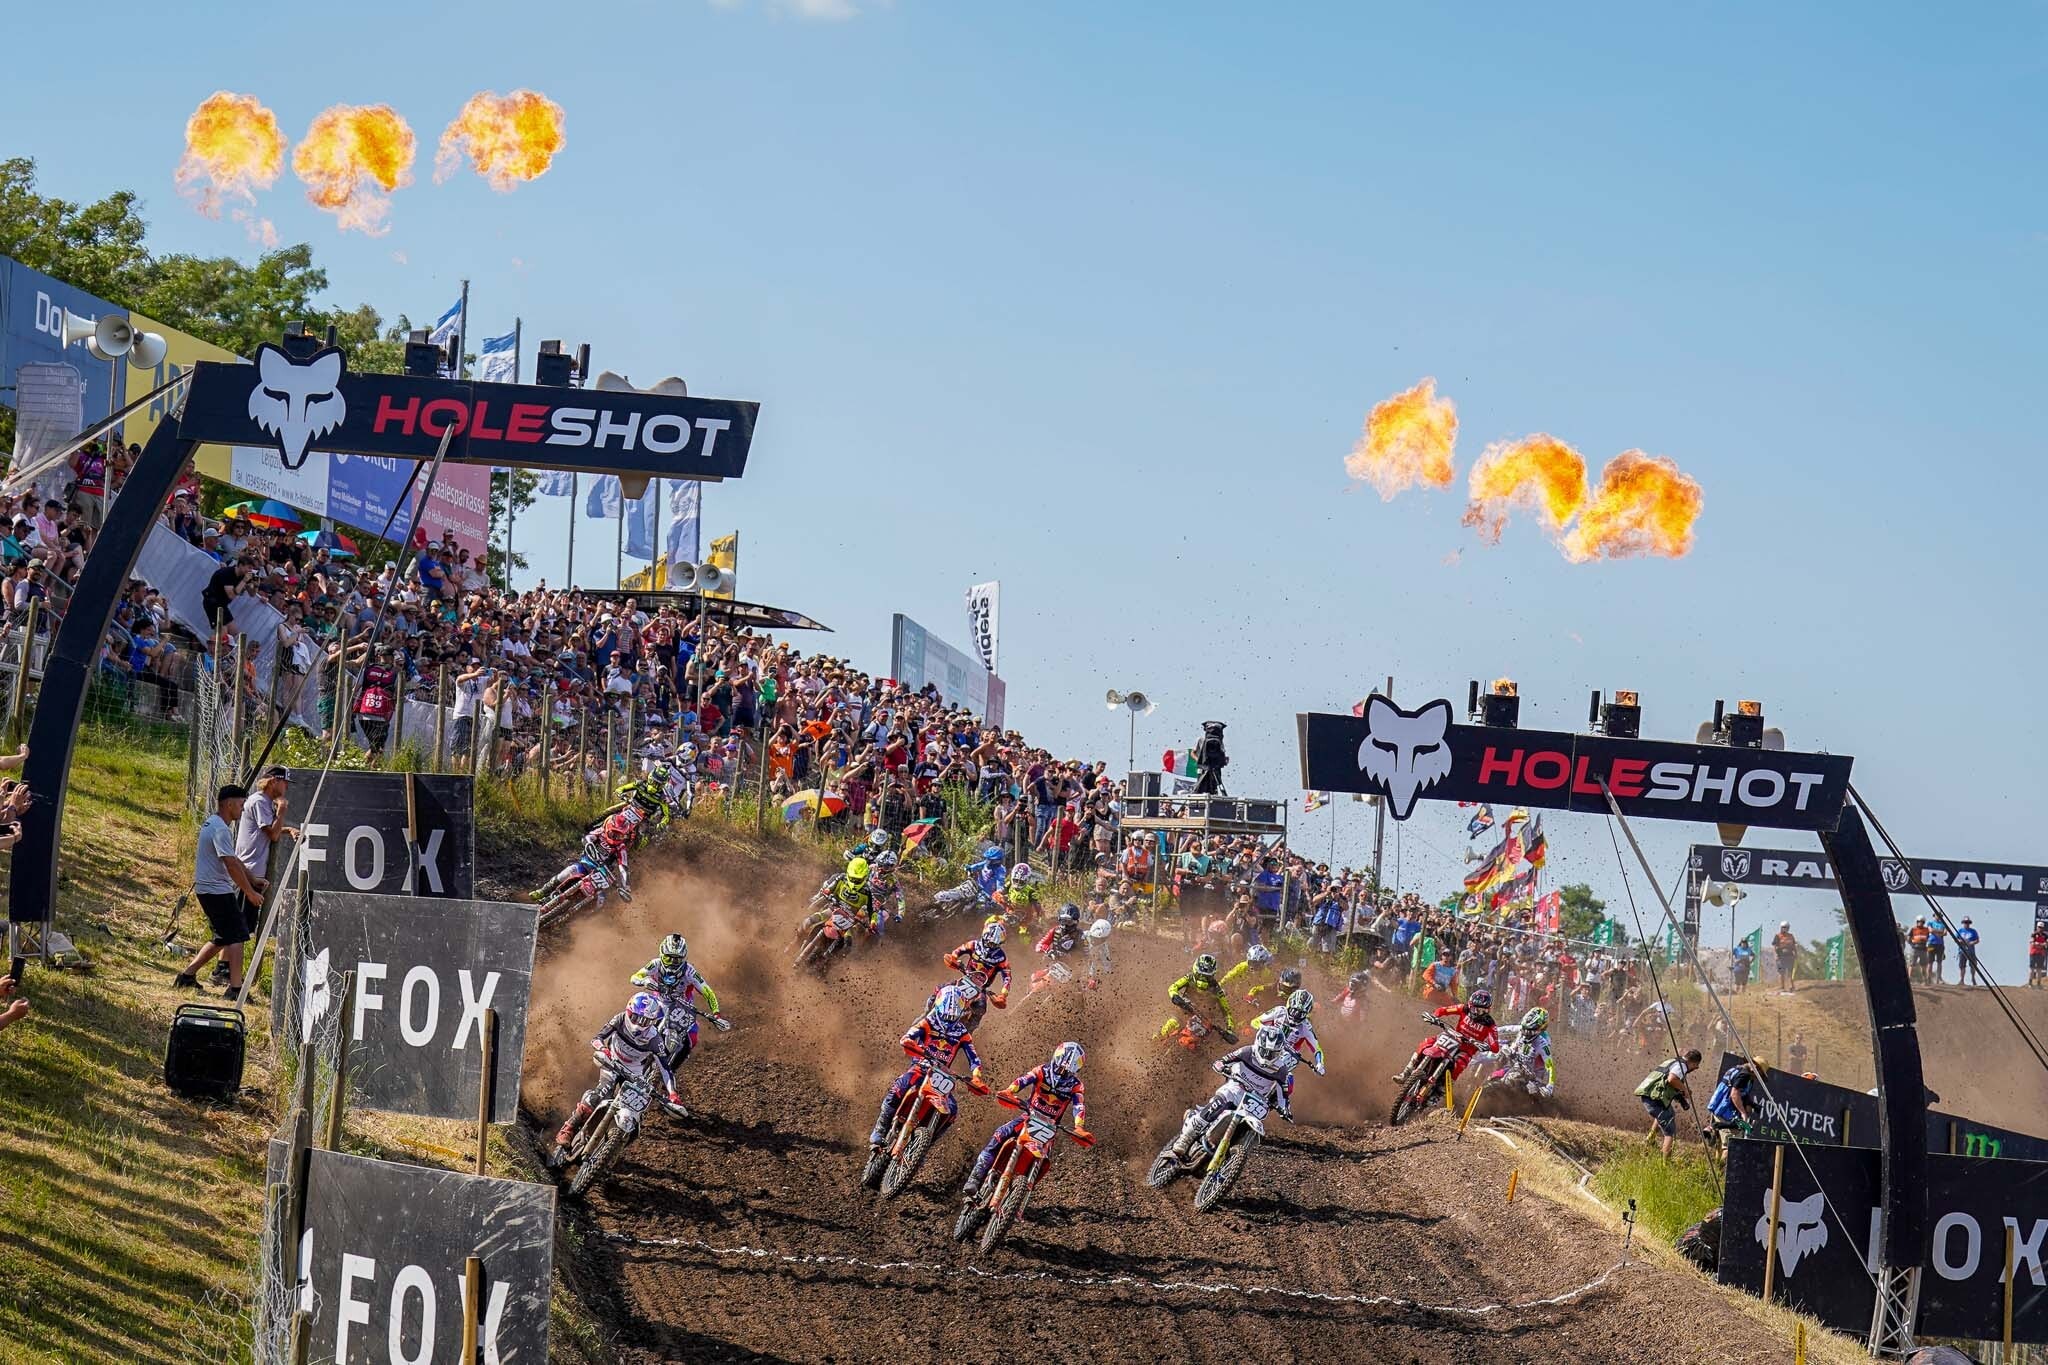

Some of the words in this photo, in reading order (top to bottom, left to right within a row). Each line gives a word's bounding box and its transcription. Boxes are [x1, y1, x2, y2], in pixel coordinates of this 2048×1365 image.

[373, 395, 731, 457] HOLESHOT
[1478, 747, 1824, 811] HOLESHOT
[298, 823, 445, 894] FOX
[1921, 869, 2024, 892] RAM
[959, 979, 979, 999] 79
[353, 961, 501, 1050] FOX
[931, 1072, 954, 1094] 80
[1246, 1098, 1268, 1120] 39
[1028, 1119, 1055, 1144] 72
